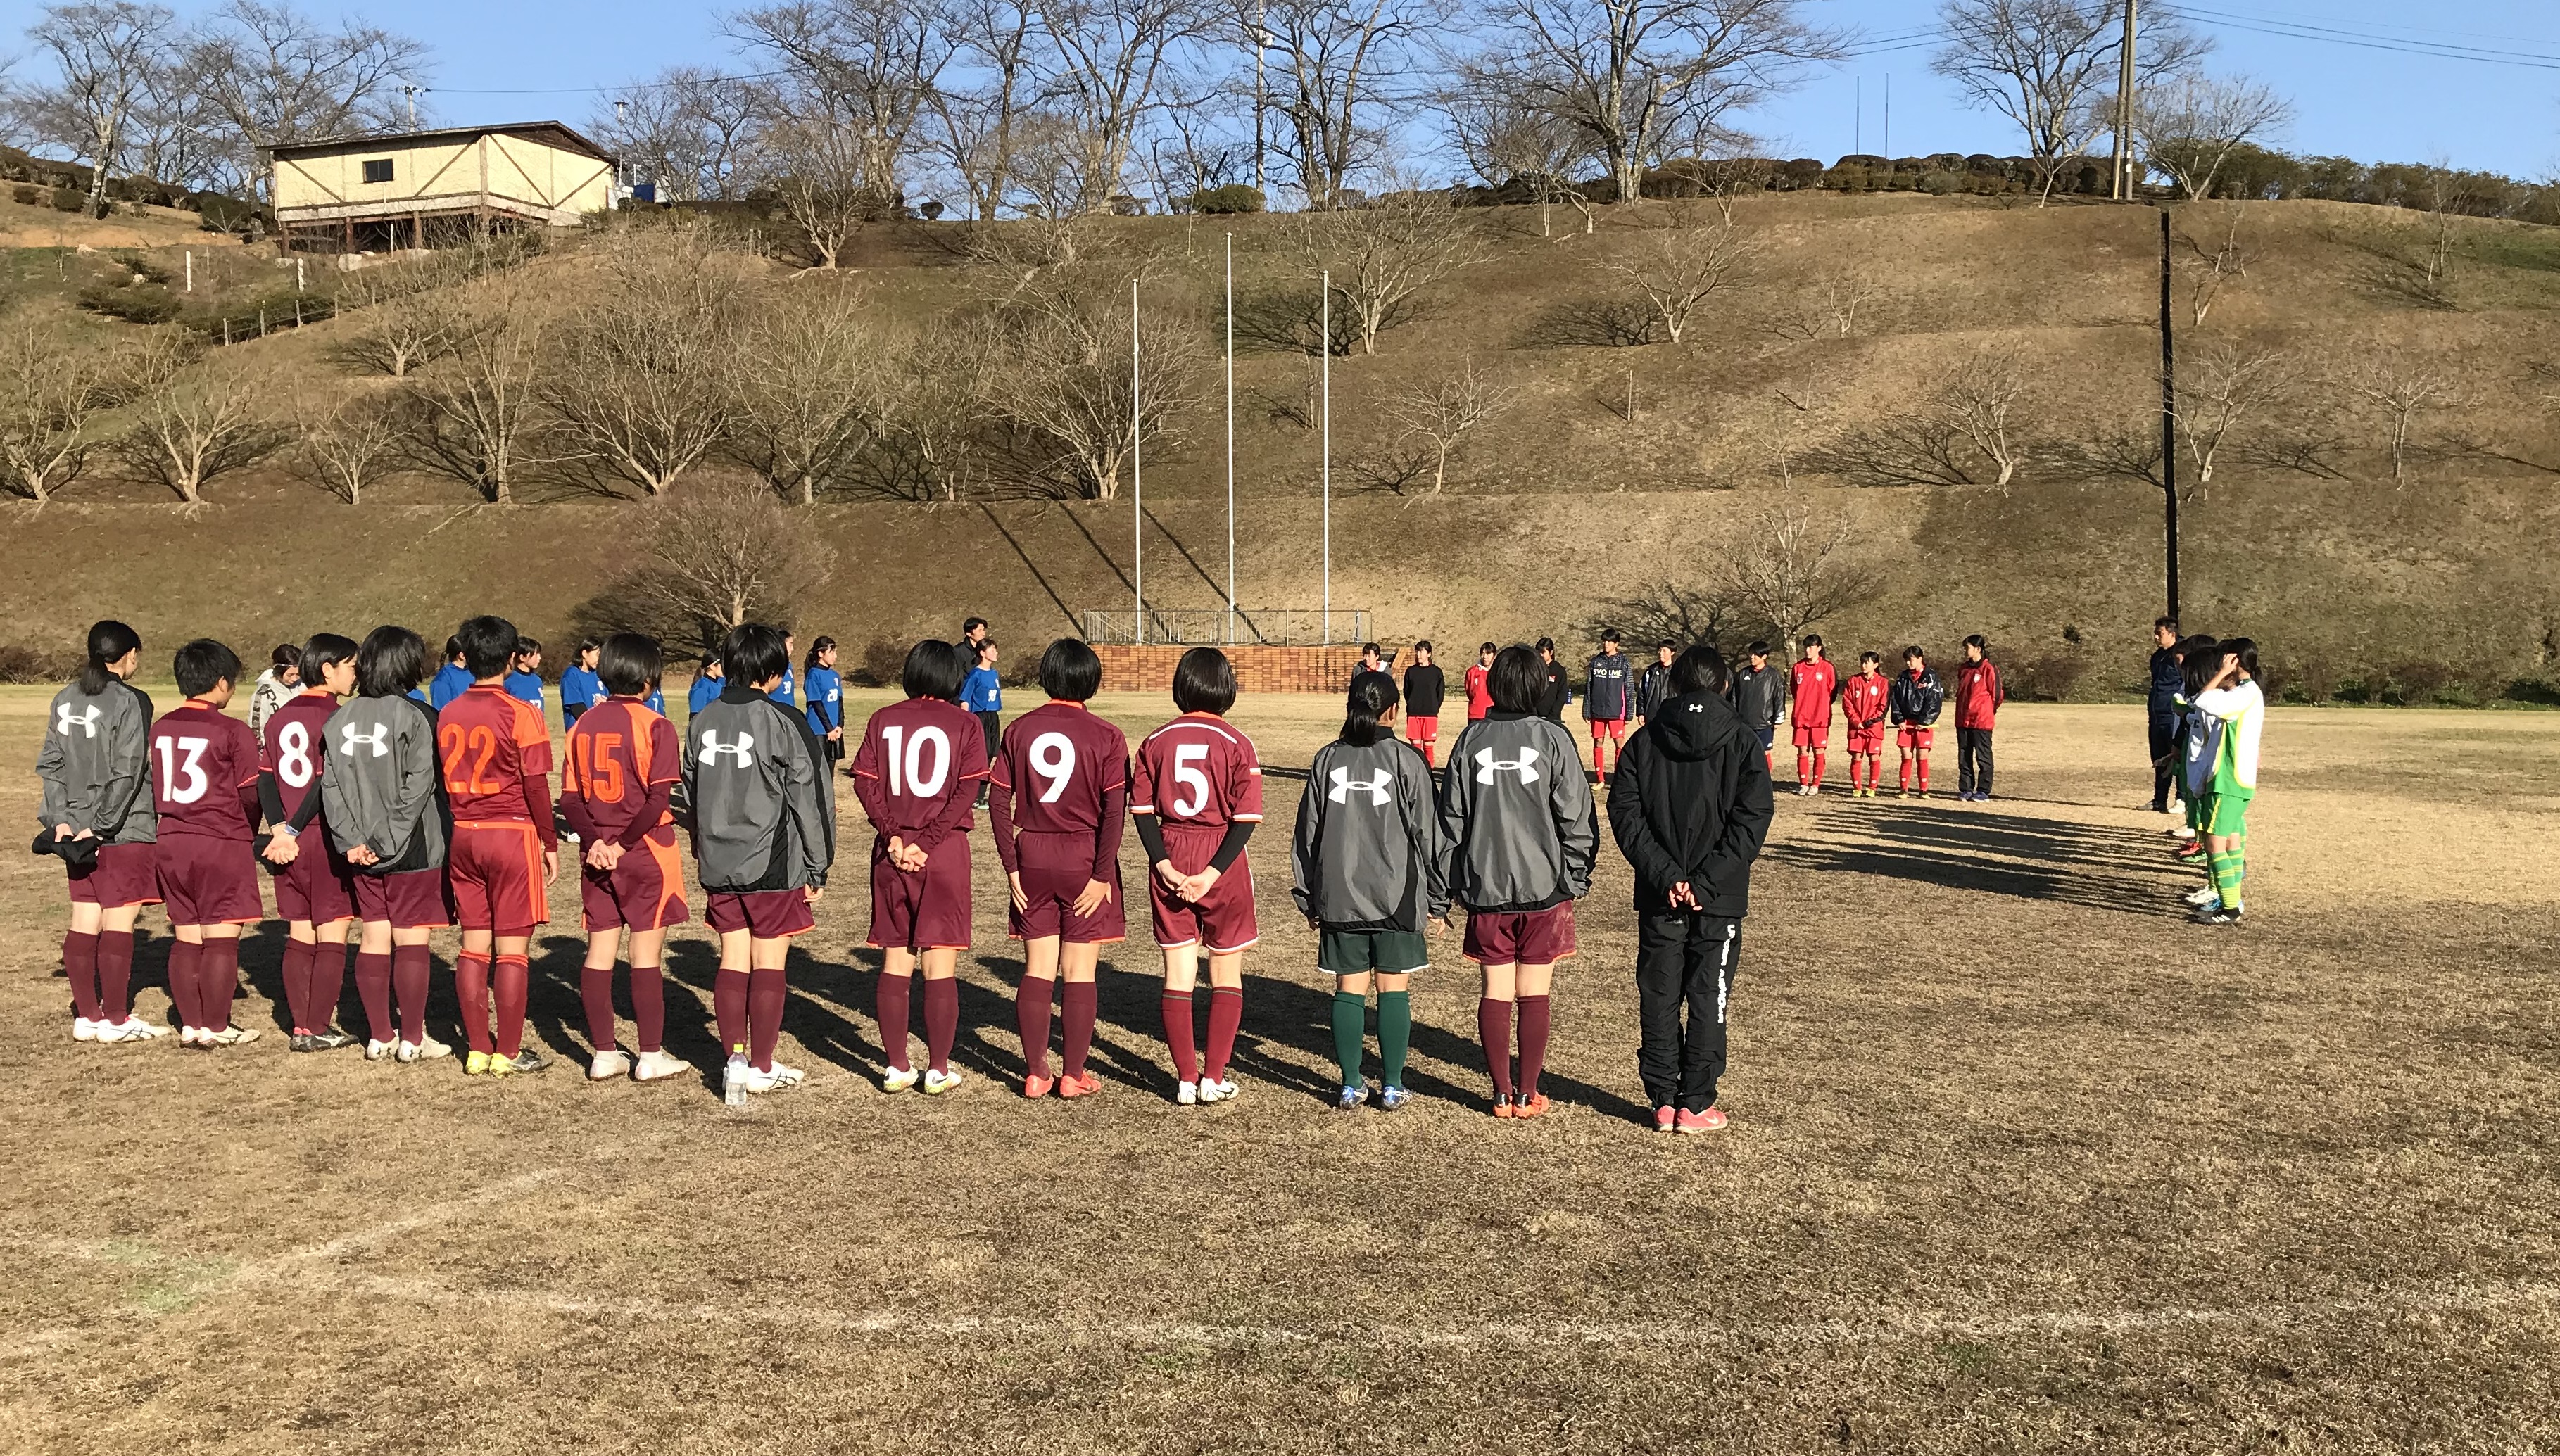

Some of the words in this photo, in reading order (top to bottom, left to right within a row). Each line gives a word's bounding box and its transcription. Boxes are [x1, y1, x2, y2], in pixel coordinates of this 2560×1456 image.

[155, 735, 209, 804] 13
[278, 721, 313, 788] 8
[439, 723, 500, 794] 22
[576, 733, 624, 804] 15
[882, 726, 950, 798] 10
[1029, 732, 1076, 803] 9
[1173, 744, 1209, 817] 5
